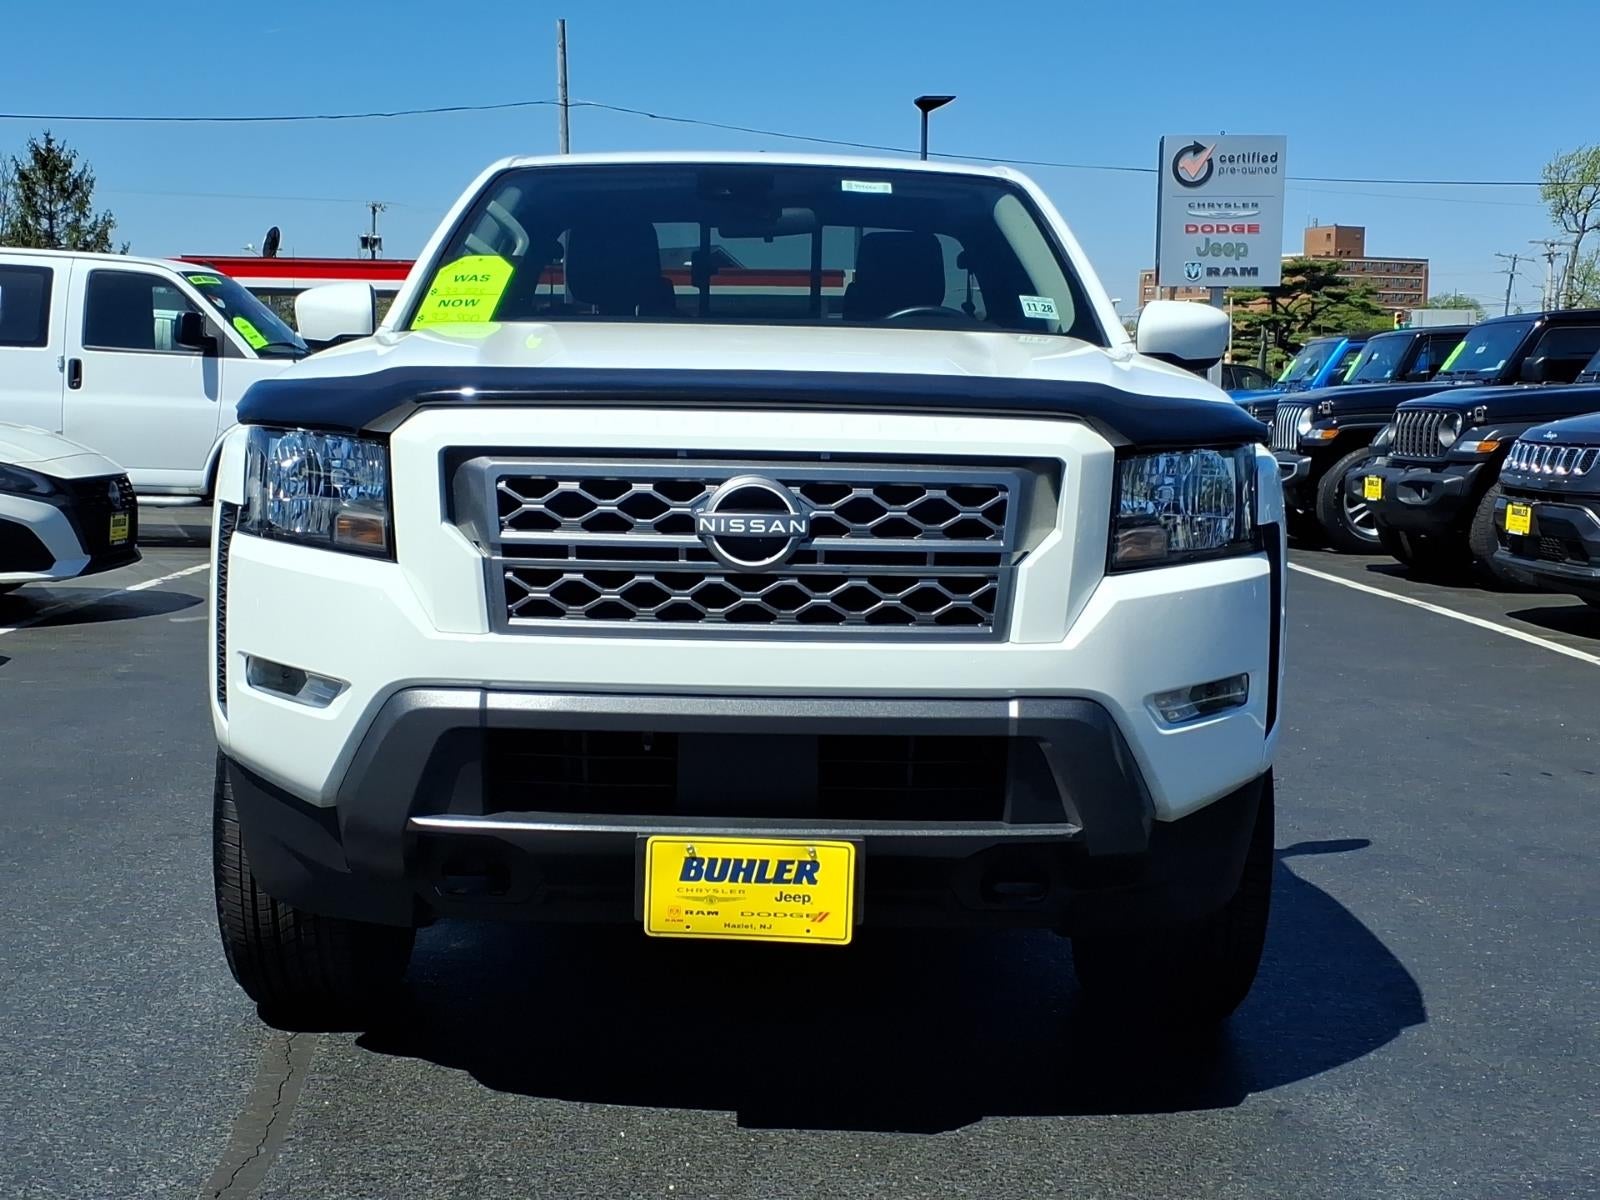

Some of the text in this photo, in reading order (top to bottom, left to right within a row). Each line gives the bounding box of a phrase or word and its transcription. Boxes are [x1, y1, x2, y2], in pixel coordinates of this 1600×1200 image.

[1219, 152, 1278, 163] certified
[1218, 165, 1278, 176] pre-owned
[1185, 224, 1260, 234] DODGE
[1196, 237, 1248, 260] Jeep
[1206, 266, 1259, 277] RAM
[454, 274, 491, 282] WAS
[438, 299, 480, 307] NOW
[1026, 302, 1054, 313] 11 28
[699, 518, 806, 533] NISSAN
[679, 856, 820, 885] BUHLER
[677, 887, 746, 895] CHRYSLER
[774, 891, 812, 905] Jeep
[740, 911, 818, 919] DODGE
